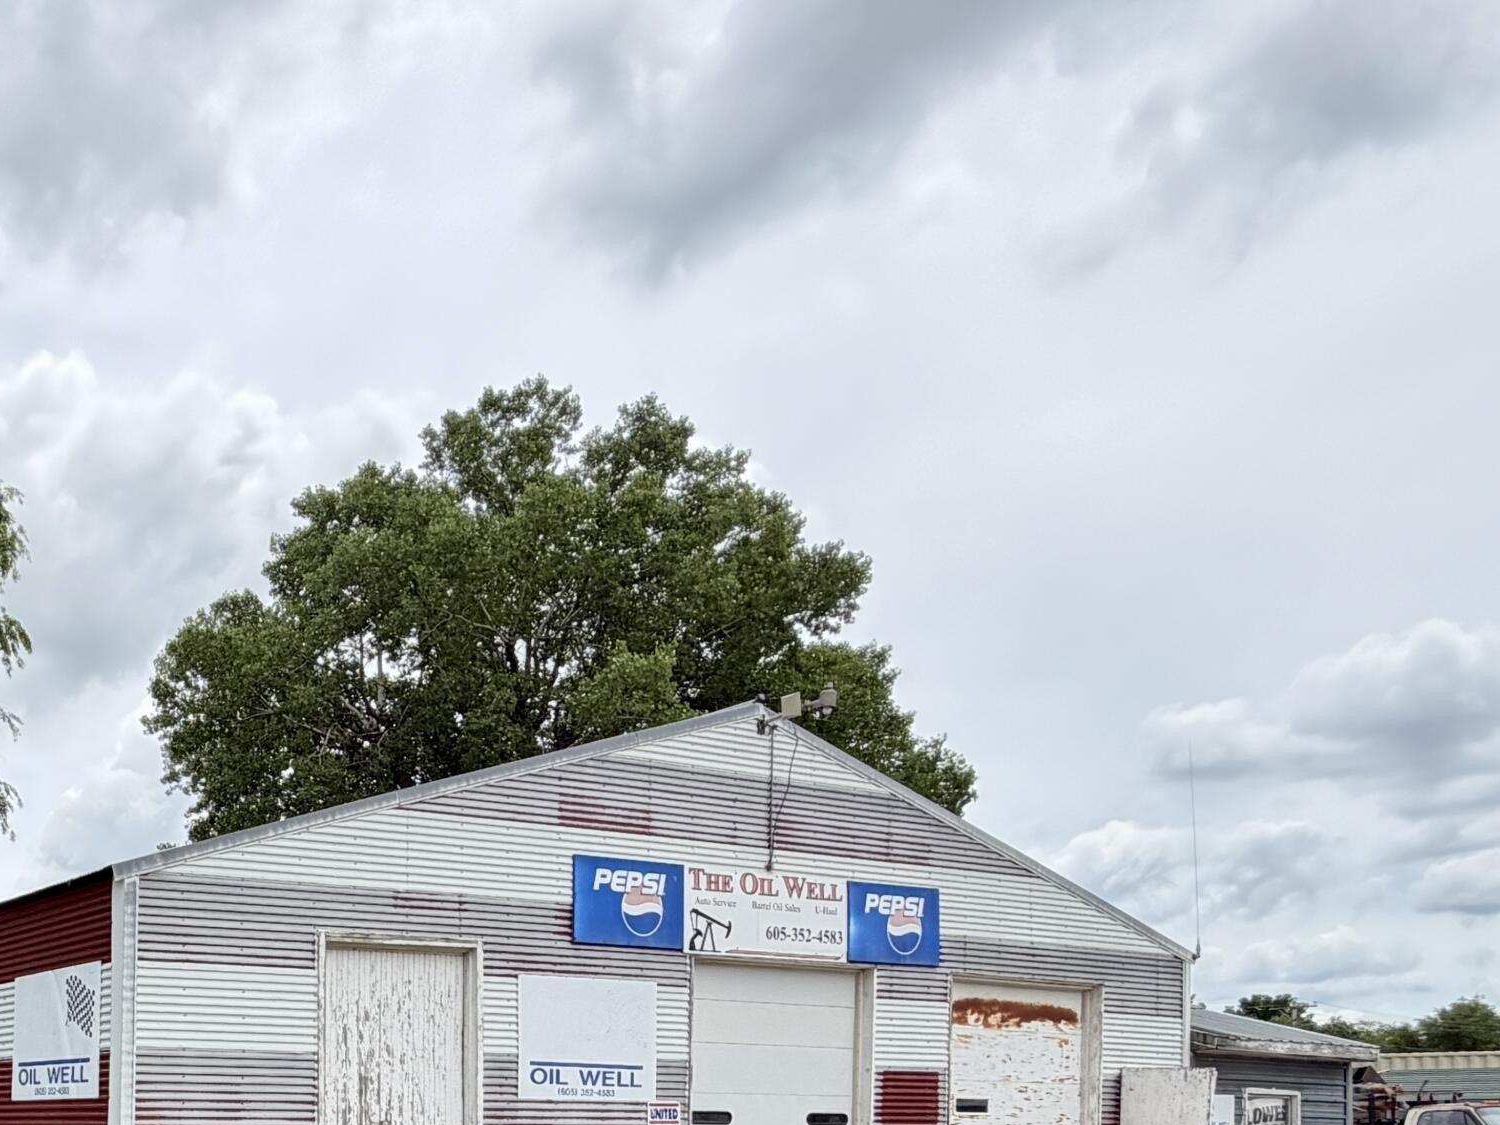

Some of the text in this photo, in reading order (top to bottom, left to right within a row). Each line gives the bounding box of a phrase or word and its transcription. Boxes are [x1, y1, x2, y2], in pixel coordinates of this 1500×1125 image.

[592, 867, 667, 896] PEPSI
[688, 867, 843, 902] THE OIL WELL
[695, 897, 737, 908] Auto Service
[752, 901, 802, 913] Barrel Oil Sales
[815, 905, 839, 916] U-Haul
[864, 893, 925, 918] PEPSI
[765, 926, 844, 945] 605-352-4583
[18, 1065, 89, 1086] OIL WELL
[530, 1067, 642, 1088] OIL WELL
[557, 1087, 615, 1097] (605) 352-4583
[650, 1108, 678, 1120] UNITED
